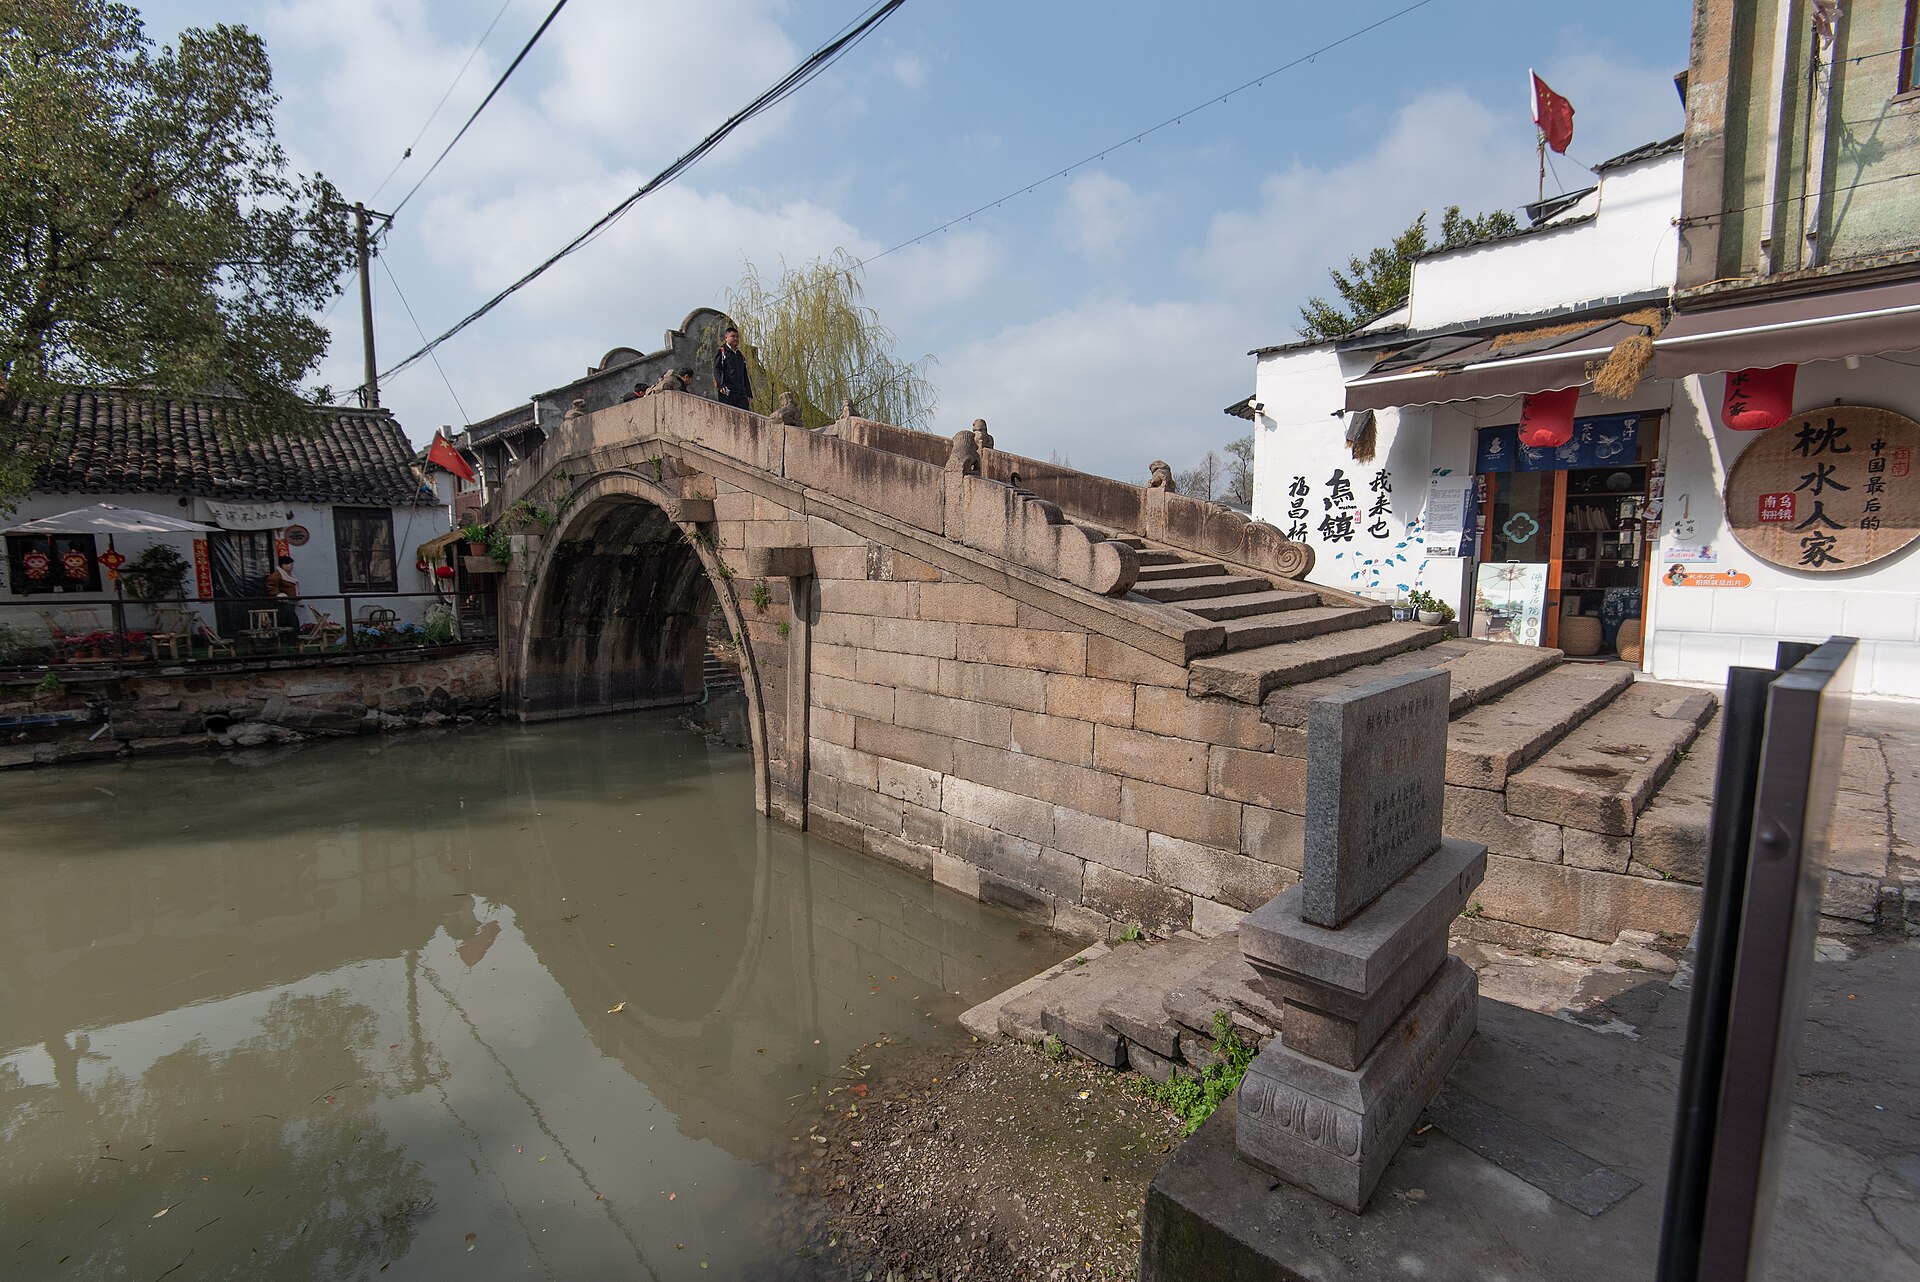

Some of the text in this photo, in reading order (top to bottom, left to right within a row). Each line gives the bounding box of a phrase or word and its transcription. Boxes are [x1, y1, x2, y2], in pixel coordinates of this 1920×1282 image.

[1729, 372, 1751, 416] 水人家
[1623, 419, 1635, 438] 果汁
[1287, 476, 1310, 543] 福昌桥
[1367, 469, 1393, 539] 我来也
[1791, 418, 1852, 567] 枕水人家
[1860, 439, 1888, 531] 中国最后的
